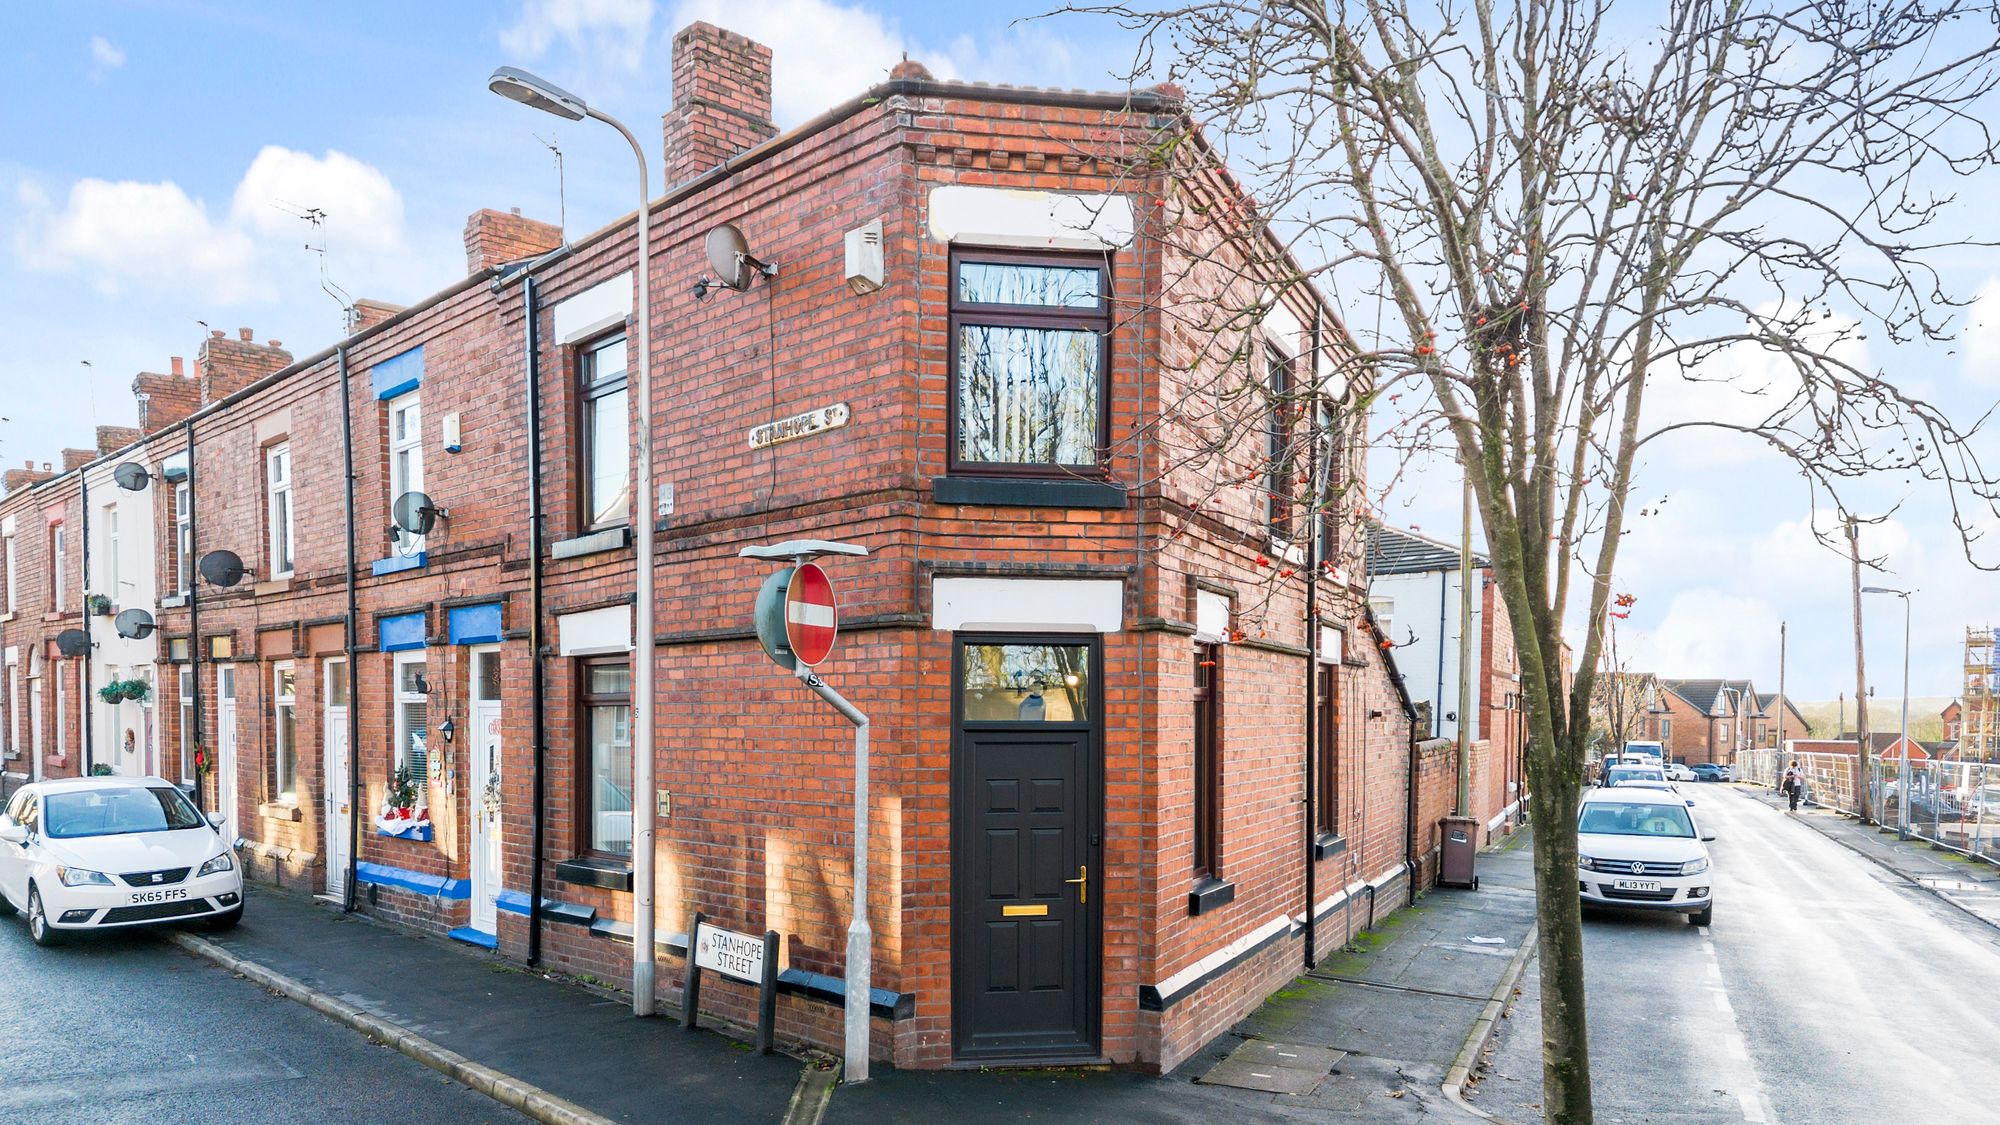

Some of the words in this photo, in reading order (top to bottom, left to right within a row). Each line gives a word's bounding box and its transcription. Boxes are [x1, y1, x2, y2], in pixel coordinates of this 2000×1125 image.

[755, 413, 816, 444] STANHOPE
[131, 891, 162, 903] SK65
[165, 888, 187, 900] FFS
[1619, 881, 1637, 889] ML13
[1640, 882, 1655, 890] YYT
[712, 932, 762, 960] STANHOPE
[717, 951, 754, 975] STREET
